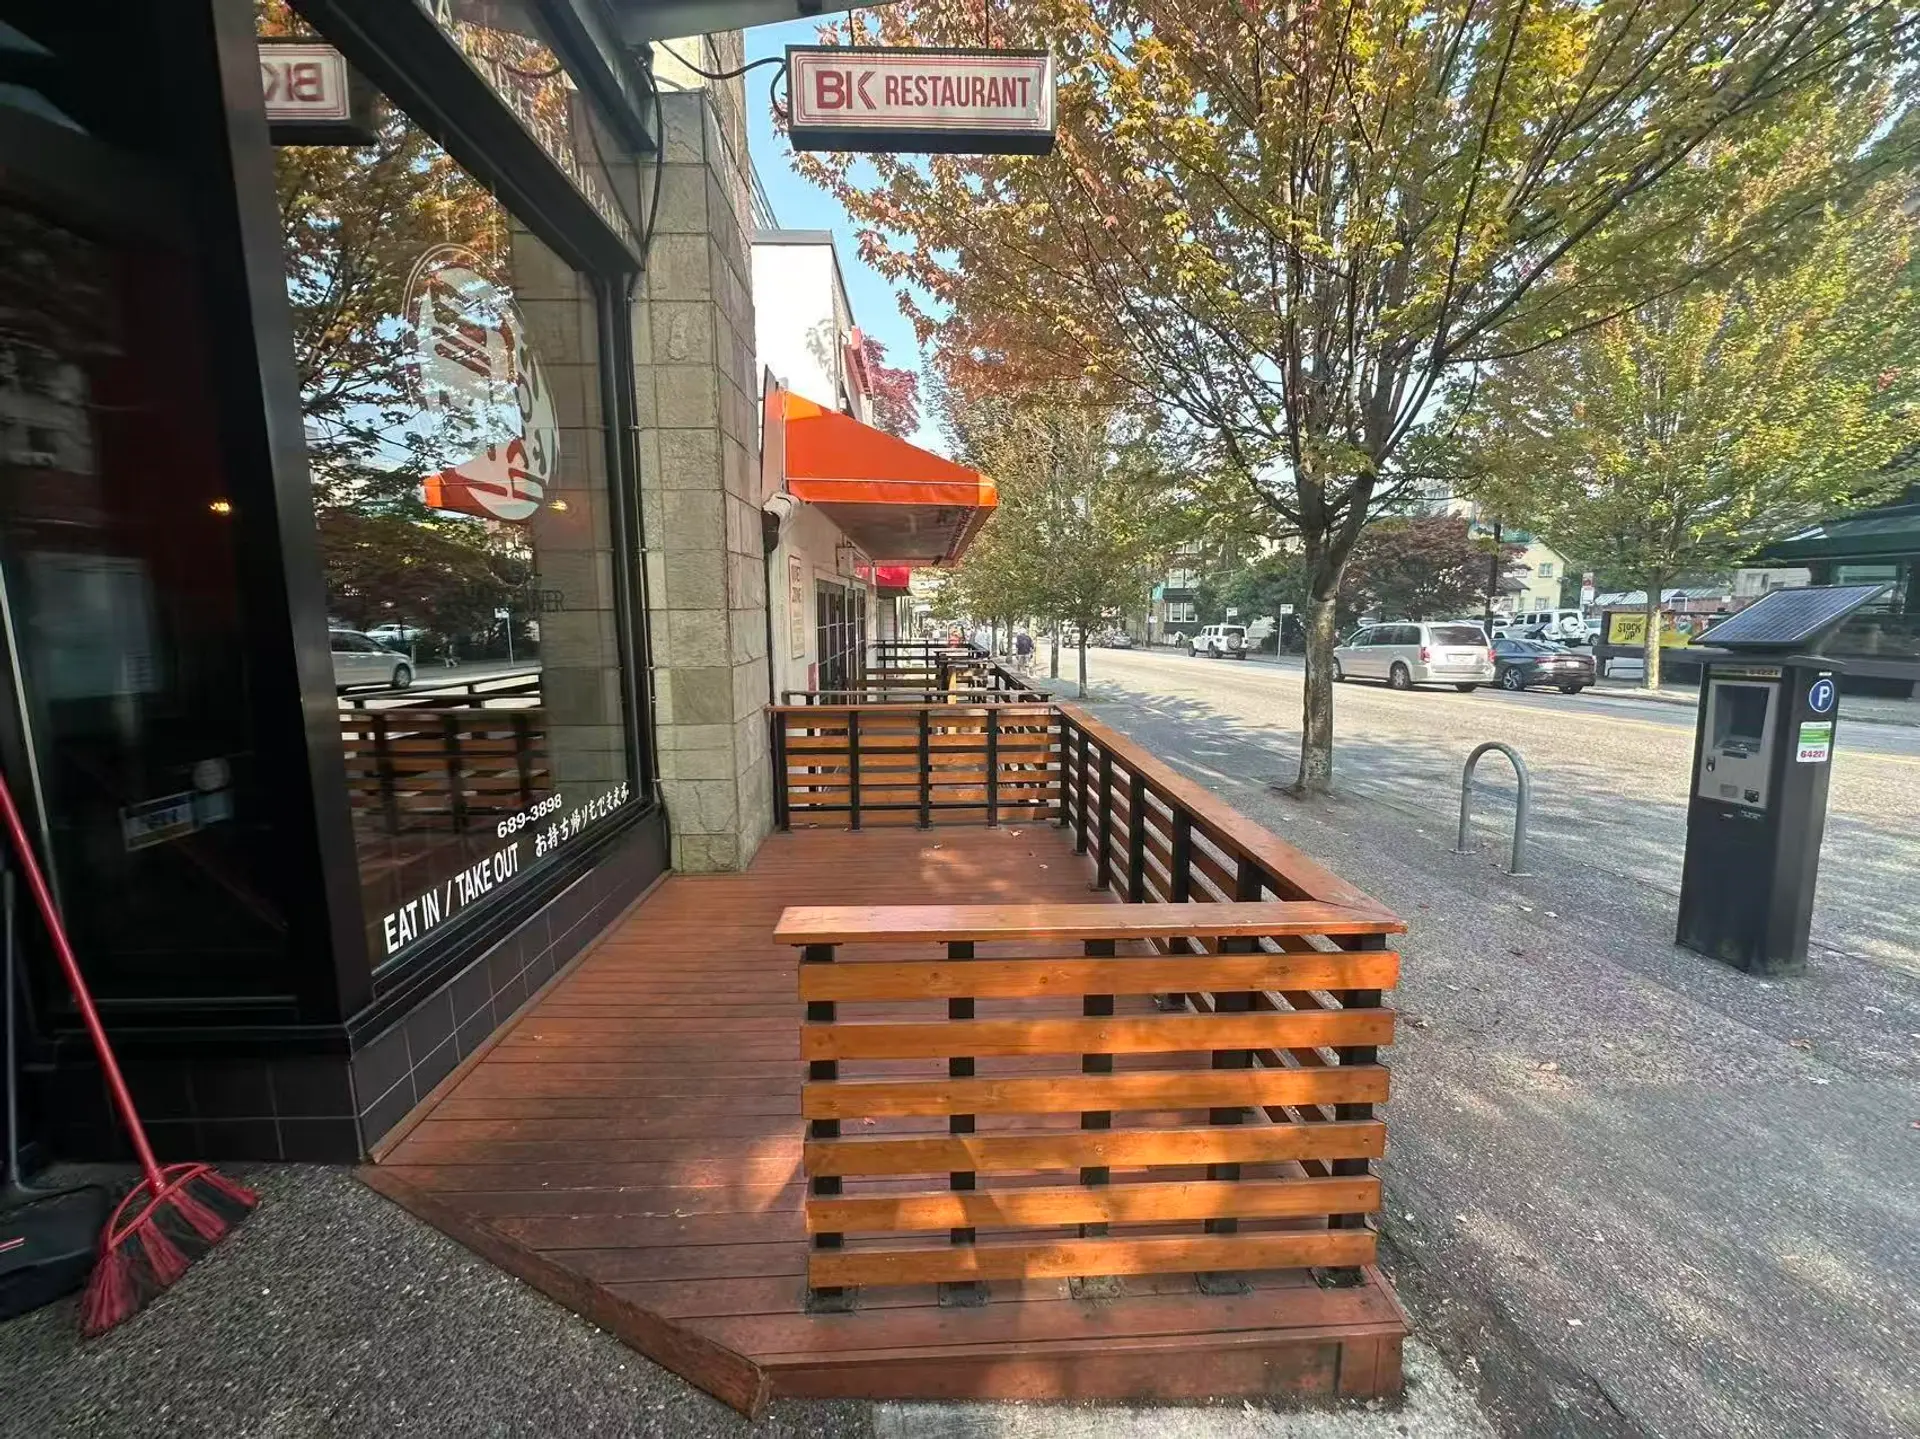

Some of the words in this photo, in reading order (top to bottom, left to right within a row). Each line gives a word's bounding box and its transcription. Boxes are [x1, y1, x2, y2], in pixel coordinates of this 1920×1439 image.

[815, 70, 877, 110] BK
[885, 75, 1031, 108] RESTAURANT
[1617, 622, 1641, 633] STOCK
[1624, 631, 1636, 640] UP
[1818, 686, 1830, 707] P
[497, 793, 562, 838] 689-3898
[383, 899, 418, 954] EAT
[421, 888, 441, 930] IN
[455, 858, 493, 906] TAKE
[494, 842, 519, 882] OUT
